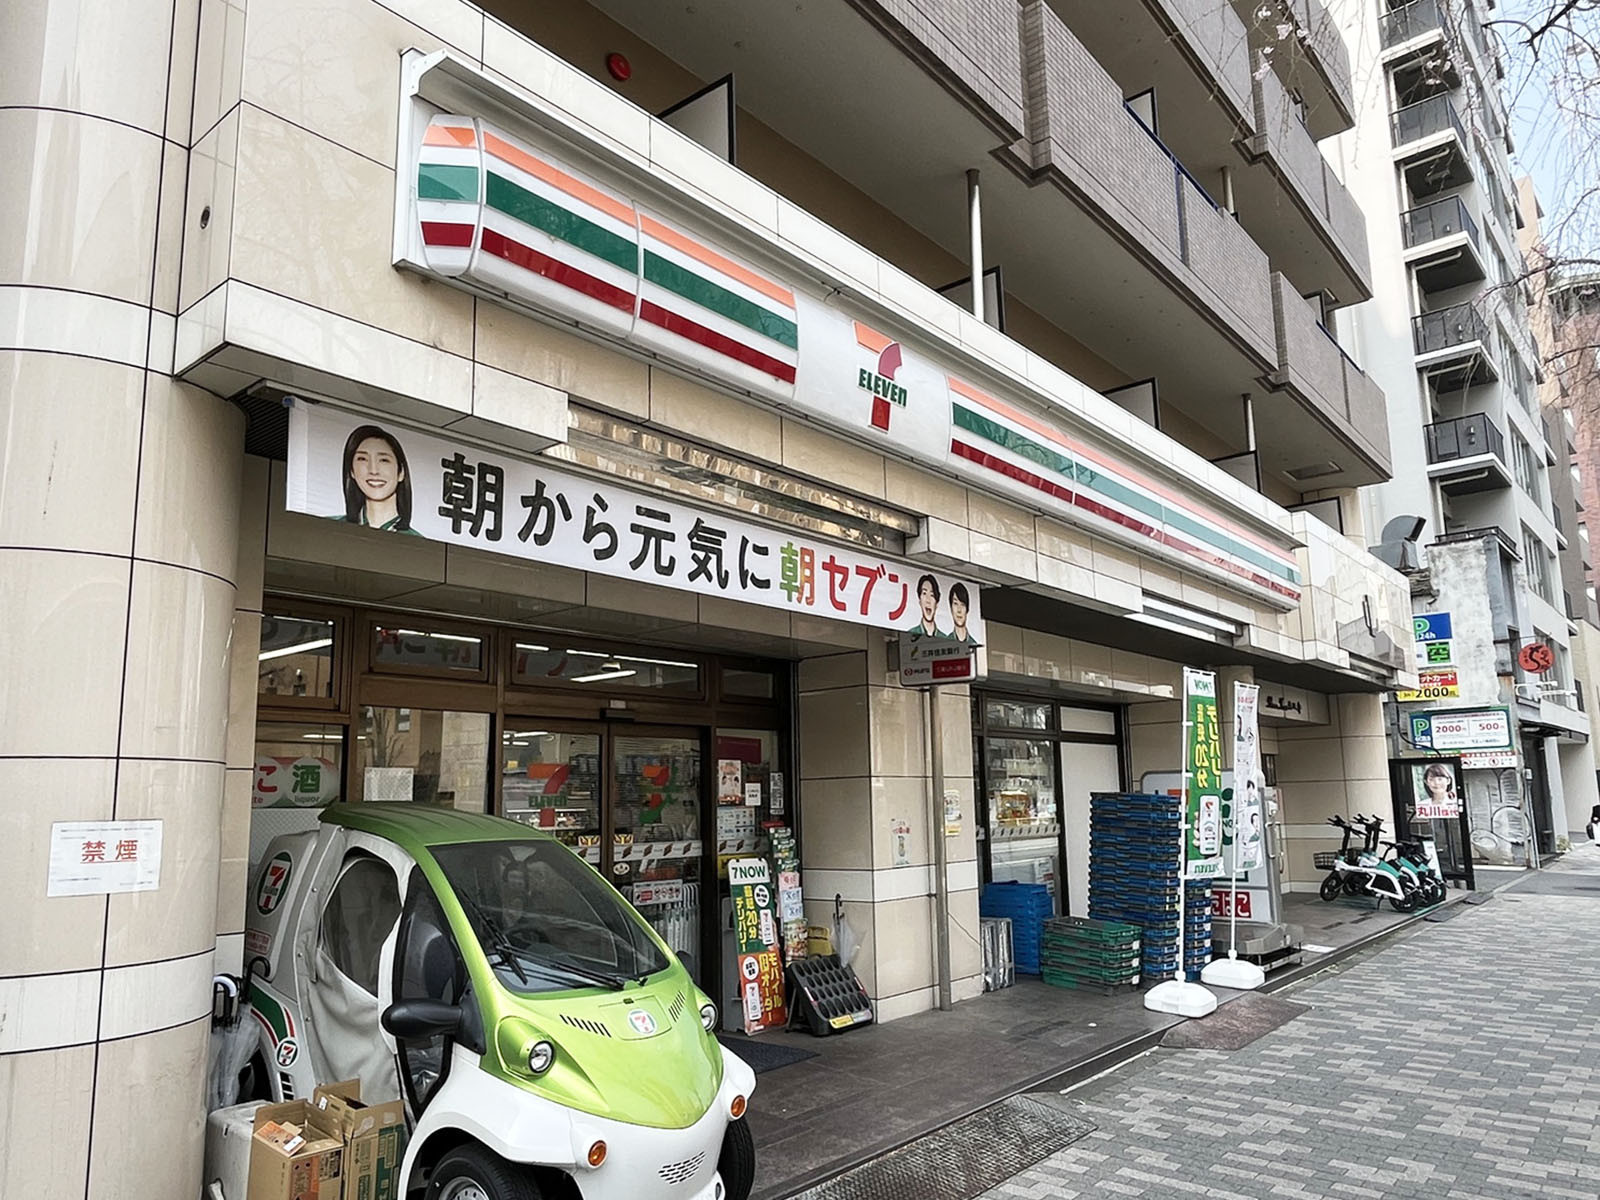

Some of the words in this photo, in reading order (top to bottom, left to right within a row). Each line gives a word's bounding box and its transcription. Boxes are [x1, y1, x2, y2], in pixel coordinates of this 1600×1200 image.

[436, 452, 909, 621] 朝から元気に朝セブン
[254, 765, 278, 793] こ
[291, 764, 321, 794] 酒
[81, 839, 139, 862] 禁煙
